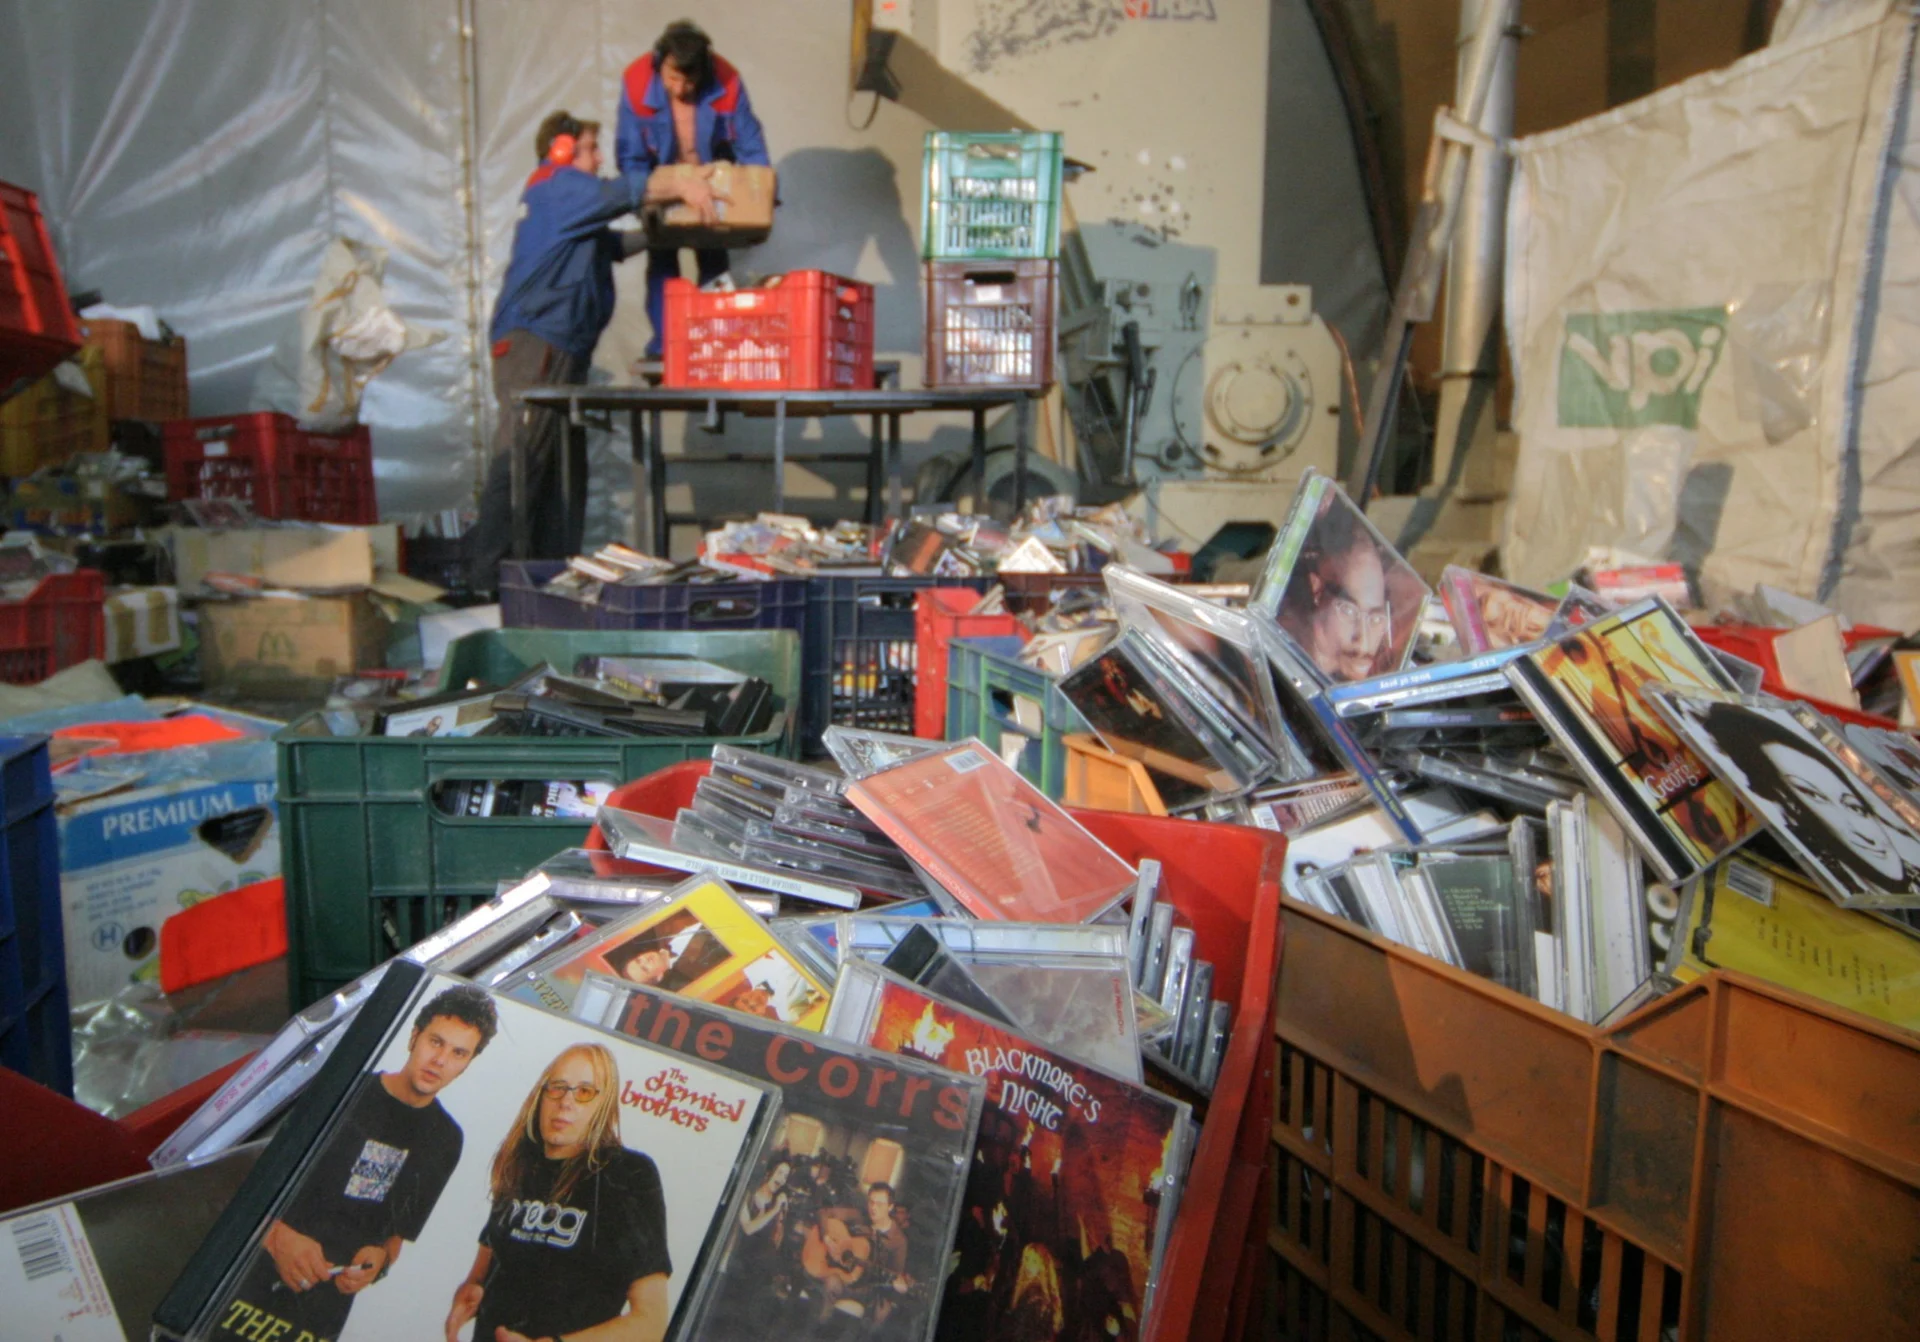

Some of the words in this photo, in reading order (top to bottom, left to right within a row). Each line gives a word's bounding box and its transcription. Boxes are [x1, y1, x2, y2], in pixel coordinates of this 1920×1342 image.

[103, 790, 234, 841] PREMIUM
[622, 993, 736, 1061] the
[764, 1035, 969, 1131] Corrs
[670, 1067, 688, 1083] The
[964, 1046, 1102, 1123] BLACKMORE'S
[620, 1080, 709, 1132] brothers
[644, 1070, 746, 1122] chemical
[998, 1082, 1063, 1131] NIGHT
[221, 1300, 292, 1342] THE
